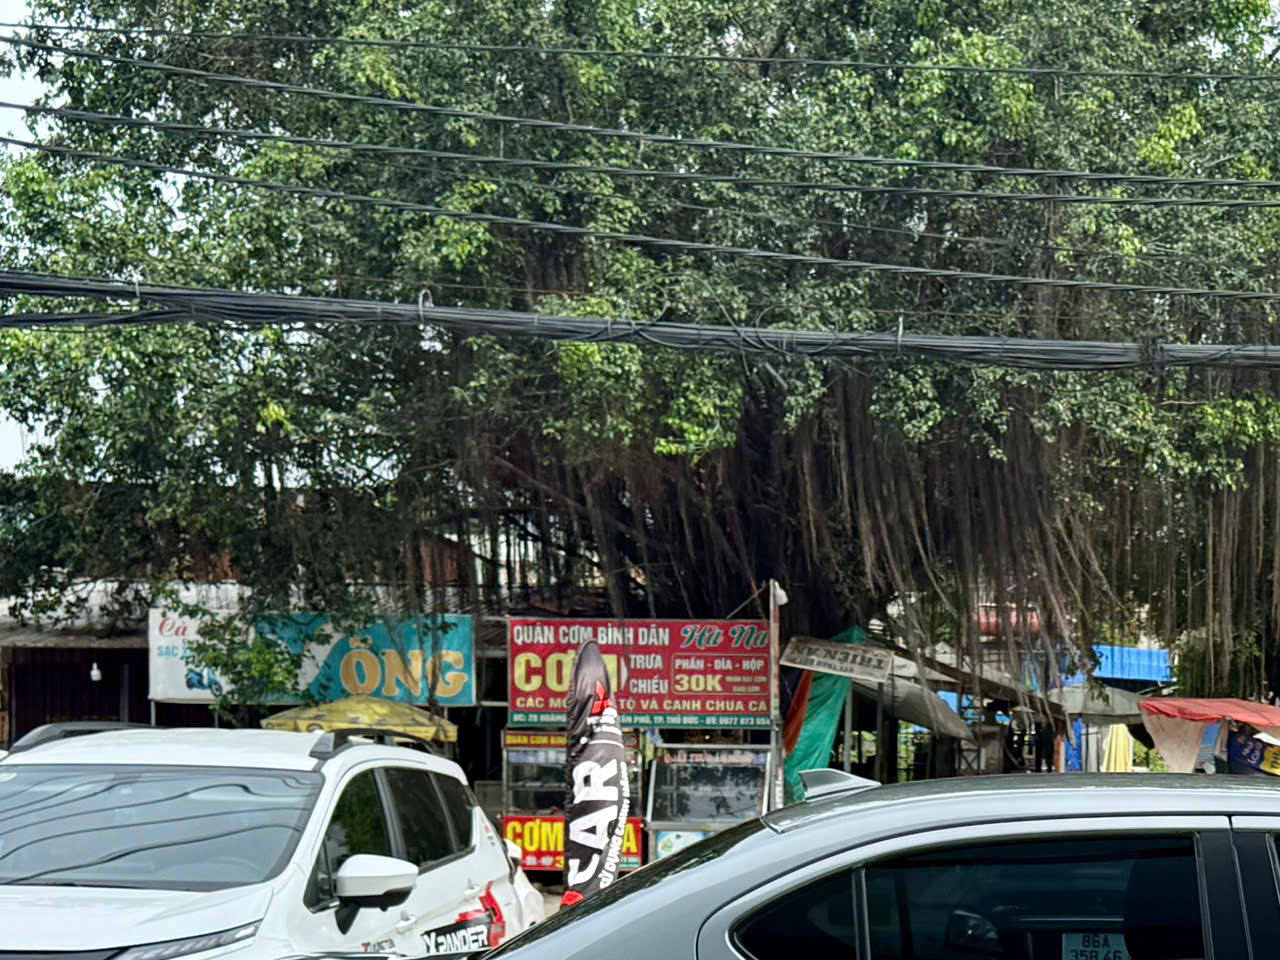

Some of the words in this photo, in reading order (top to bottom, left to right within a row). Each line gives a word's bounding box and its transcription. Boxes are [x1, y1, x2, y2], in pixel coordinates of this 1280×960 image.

[513, 622, 555, 645] QUÁN
[559, 624, 593, 645] CƠM
[597, 623, 634, 645] BÌNH
[638, 624, 669, 646] DÂN
[630, 653, 662, 670] TRƯA
[674, 674, 723, 692] 30K
[706, 699, 745, 711] CHUA
[506, 818, 565, 853] CƠM
[1082, 934, 1111, 949] 86A
